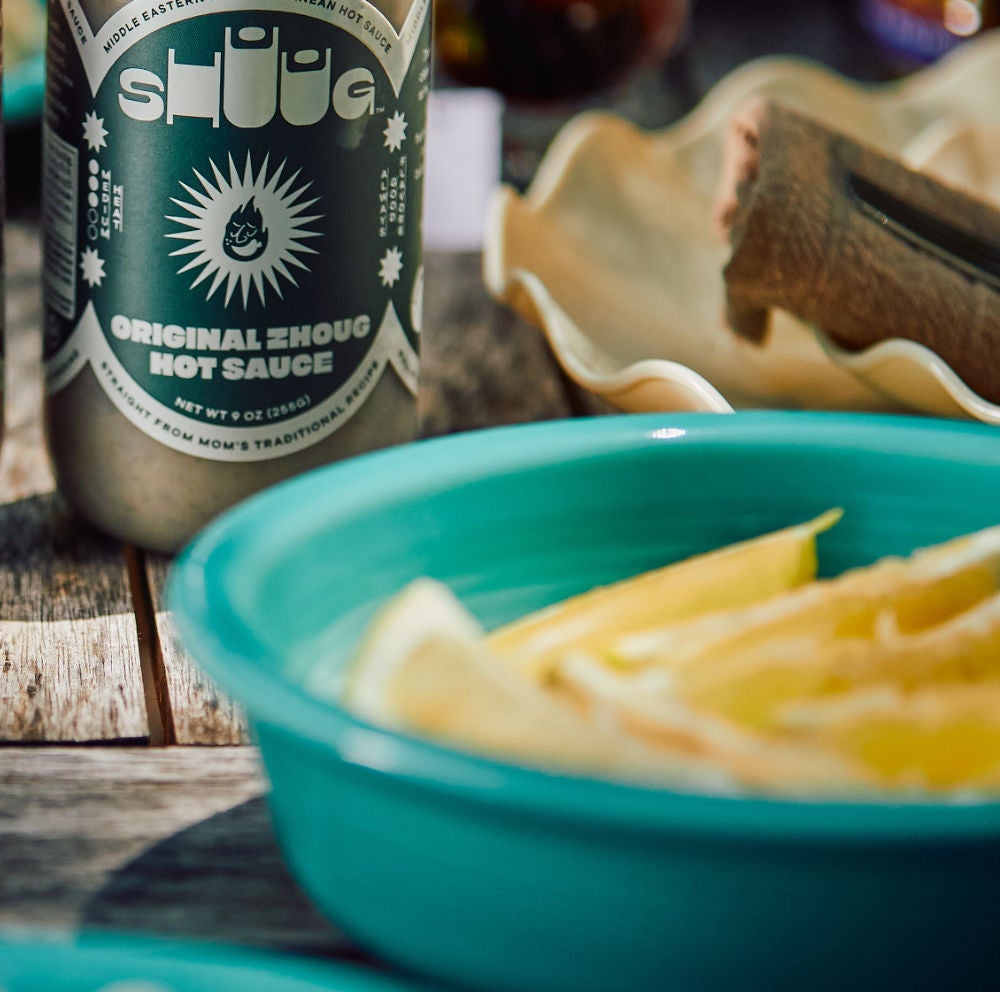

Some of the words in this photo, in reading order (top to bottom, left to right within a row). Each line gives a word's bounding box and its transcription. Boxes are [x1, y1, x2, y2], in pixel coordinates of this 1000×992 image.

[103, 16, 141, 55] MIDDLE
[339, 4, 363, 24] HOT
[363, 19, 392, 55] SAUCE
[101, 170, 111, 240] MEDIUM
[112, 184, 122, 230] HEAT
[379, 169, 388, 237] ALWAYS
[389, 177, 397, 223] GOOD
[110, 314, 261, 351] ORIGINAL
[266, 314, 372, 350] ZHOUG
[149, 352, 218, 380] HOT
[221, 350, 334, 380] SAUCE
[100, 361, 153, 422] STRAIGHT
[154, 418, 195, 443] FROM
[198, 436, 250, 452] MOM'S
[253, 406, 346, 450] TRADITIONAL
[345, 359, 380, 407] RECIPE
[174, 395, 203, 415] NET
[205, 408, 228, 421] WT
[231, 408, 240, 421] 9
[242, 408, 264, 421] OZ
